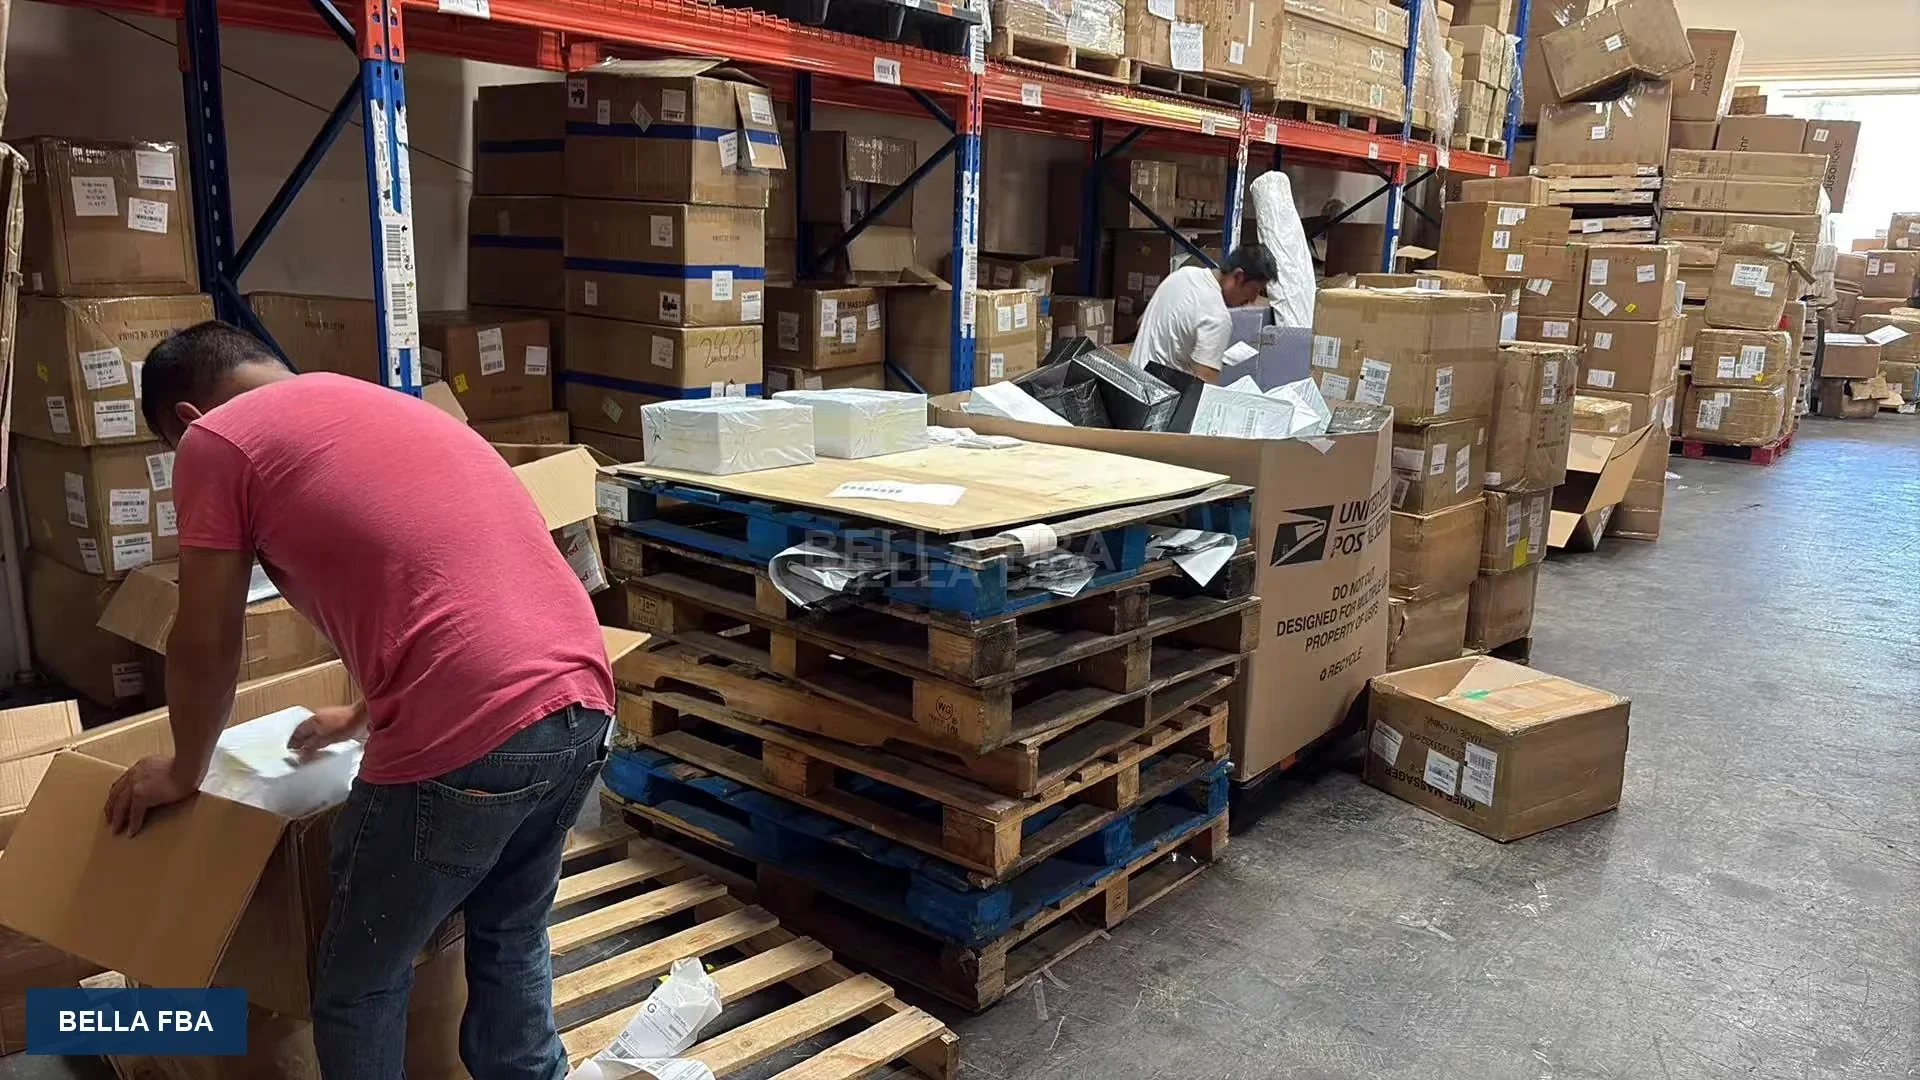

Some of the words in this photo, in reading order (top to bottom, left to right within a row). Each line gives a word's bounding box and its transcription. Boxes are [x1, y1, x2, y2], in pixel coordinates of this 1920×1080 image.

[1825, 139, 1843, 192] JUSOHOME
[1332, 584, 1348, 601] DO
[1350, 575, 1366, 596] NOT
[1277, 608, 1338, 636] DESIGNED
[1339, 600, 1357, 620] FOR
[1305, 620, 1355, 652] PROPERTY
[1328, 646, 1363, 678] RECYCLE
[647, 1003, 657, 1014] G
